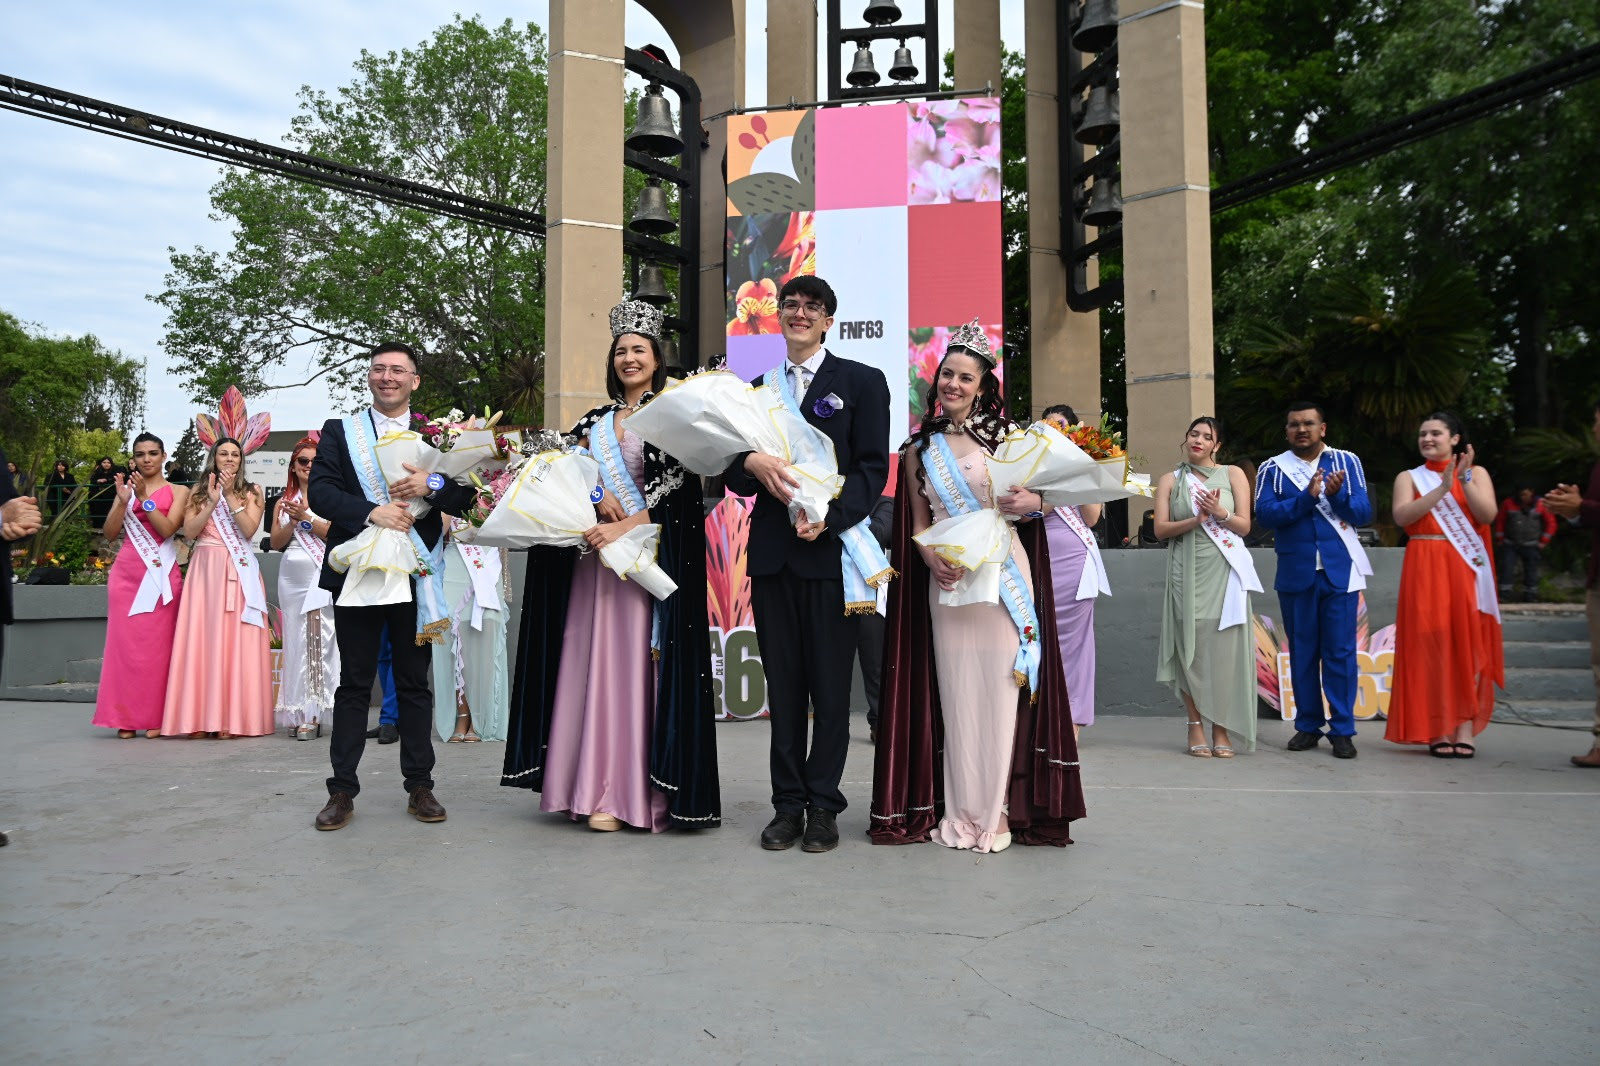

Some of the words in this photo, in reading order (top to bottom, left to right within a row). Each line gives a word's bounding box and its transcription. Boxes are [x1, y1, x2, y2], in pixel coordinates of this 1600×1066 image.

[840, 320, 883, 340] FNF63
[430, 474, 440, 488] 10
[608, 465, 637, 514] NACIONAL
[930, 448, 966, 510] EMBAJADORA
[1004, 578, 1018, 593] LA
[1014, 595, 1031, 622] FLOR
[716, 659, 723, 667] LA
